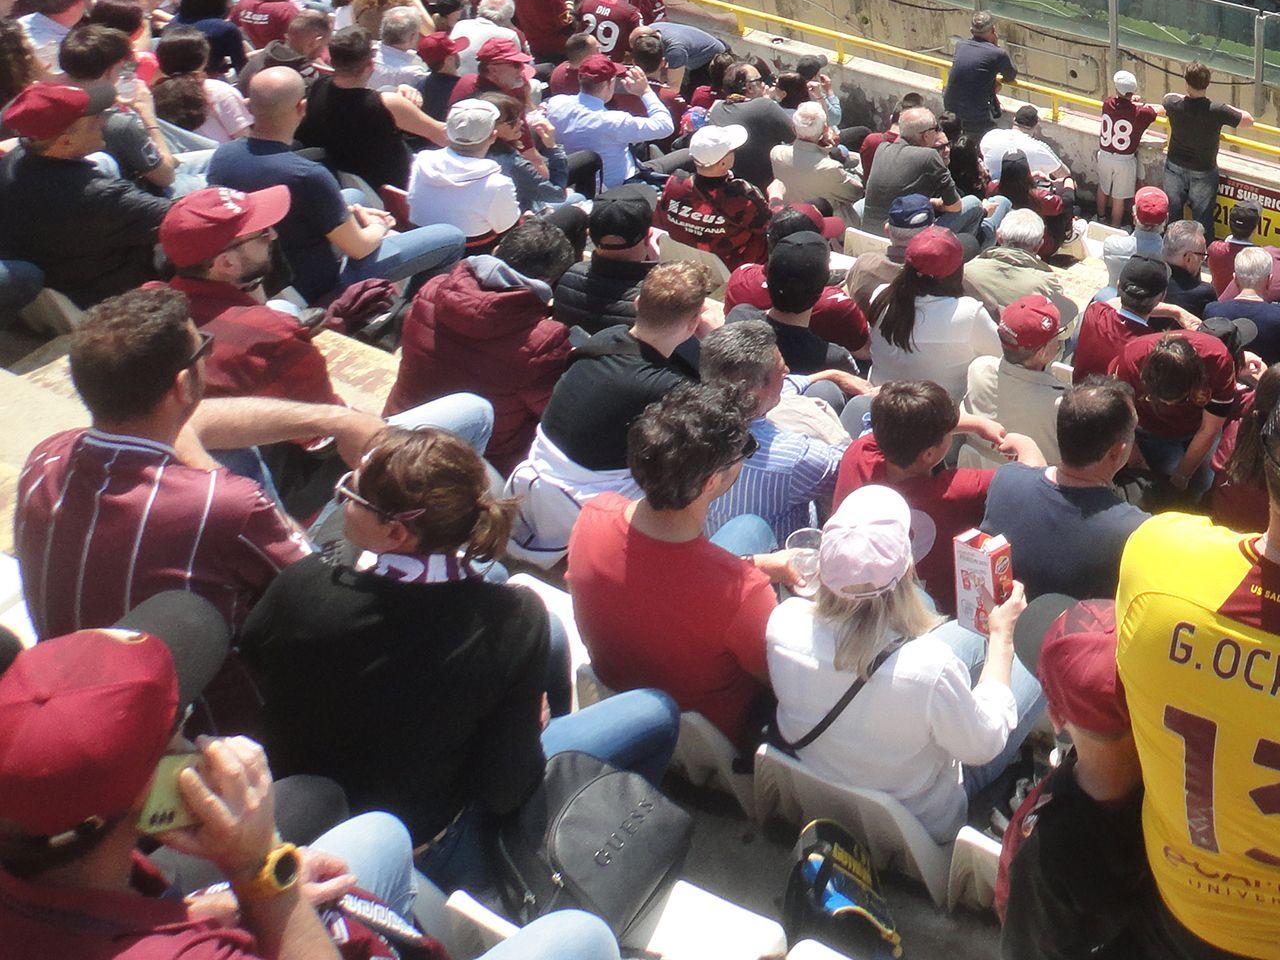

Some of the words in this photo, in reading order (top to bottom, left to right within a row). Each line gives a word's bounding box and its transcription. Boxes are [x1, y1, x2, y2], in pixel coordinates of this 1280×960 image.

[596, 5, 611, 17] DIA
[583, 13, 619, 53] 29
[1100, 114, 1133, 150] 98
[678, 205, 726, 225] Zeus
[1250, 584, 1263, 596] US
[593, 798, 656, 867] GUESS
